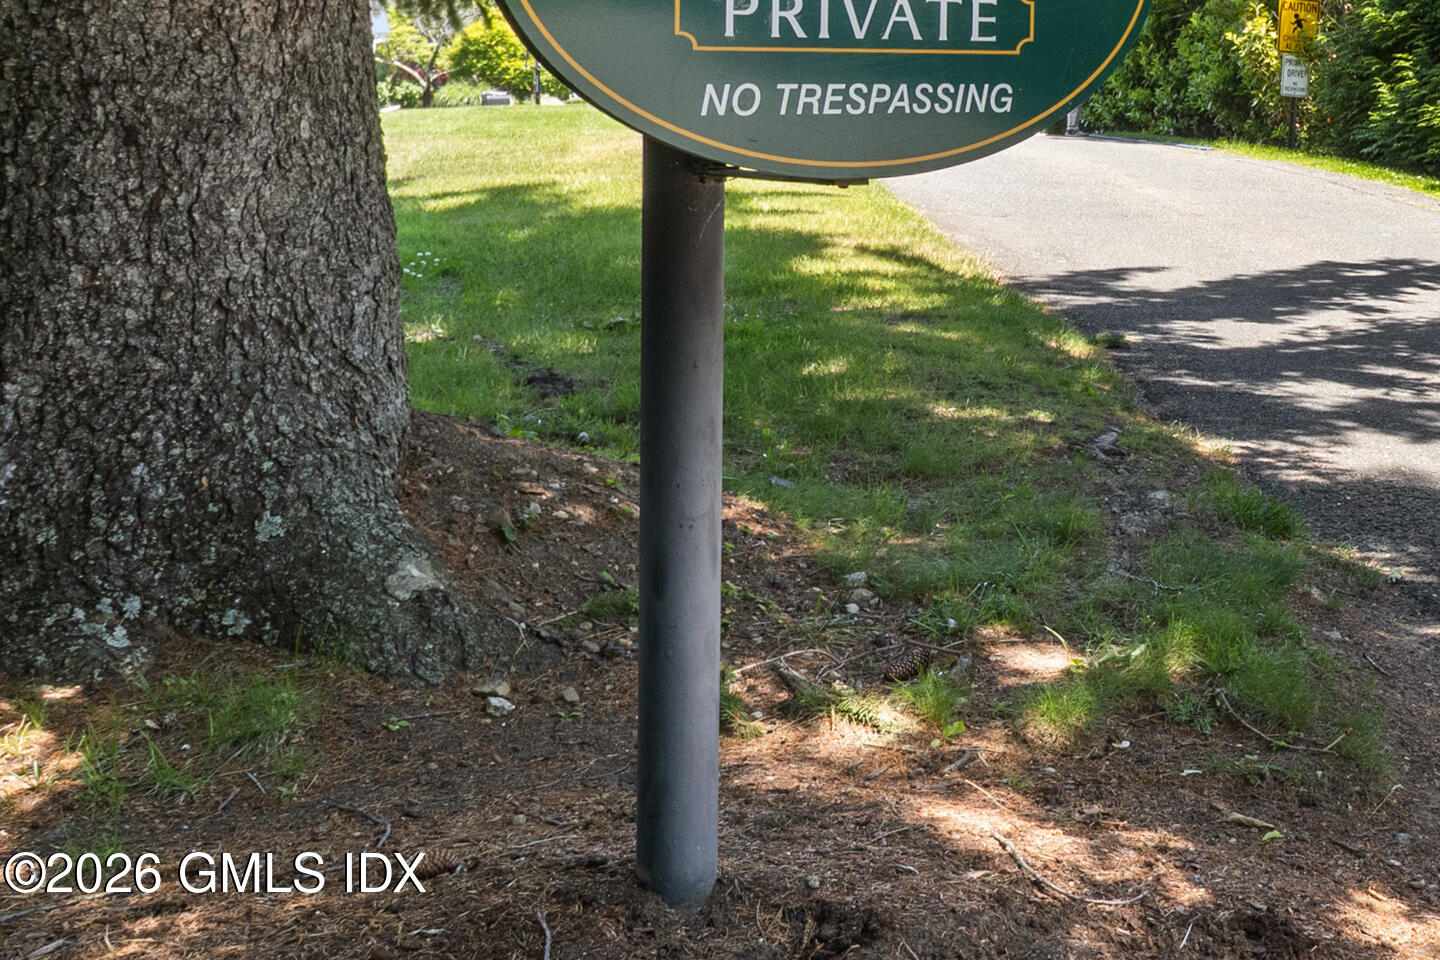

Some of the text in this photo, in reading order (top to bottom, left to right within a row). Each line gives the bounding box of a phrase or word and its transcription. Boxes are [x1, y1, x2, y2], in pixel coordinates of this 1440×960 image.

[1282, 1, 1318, 13] CAUTION
[700, 82, 1014, 116] NO TRESPASSING
